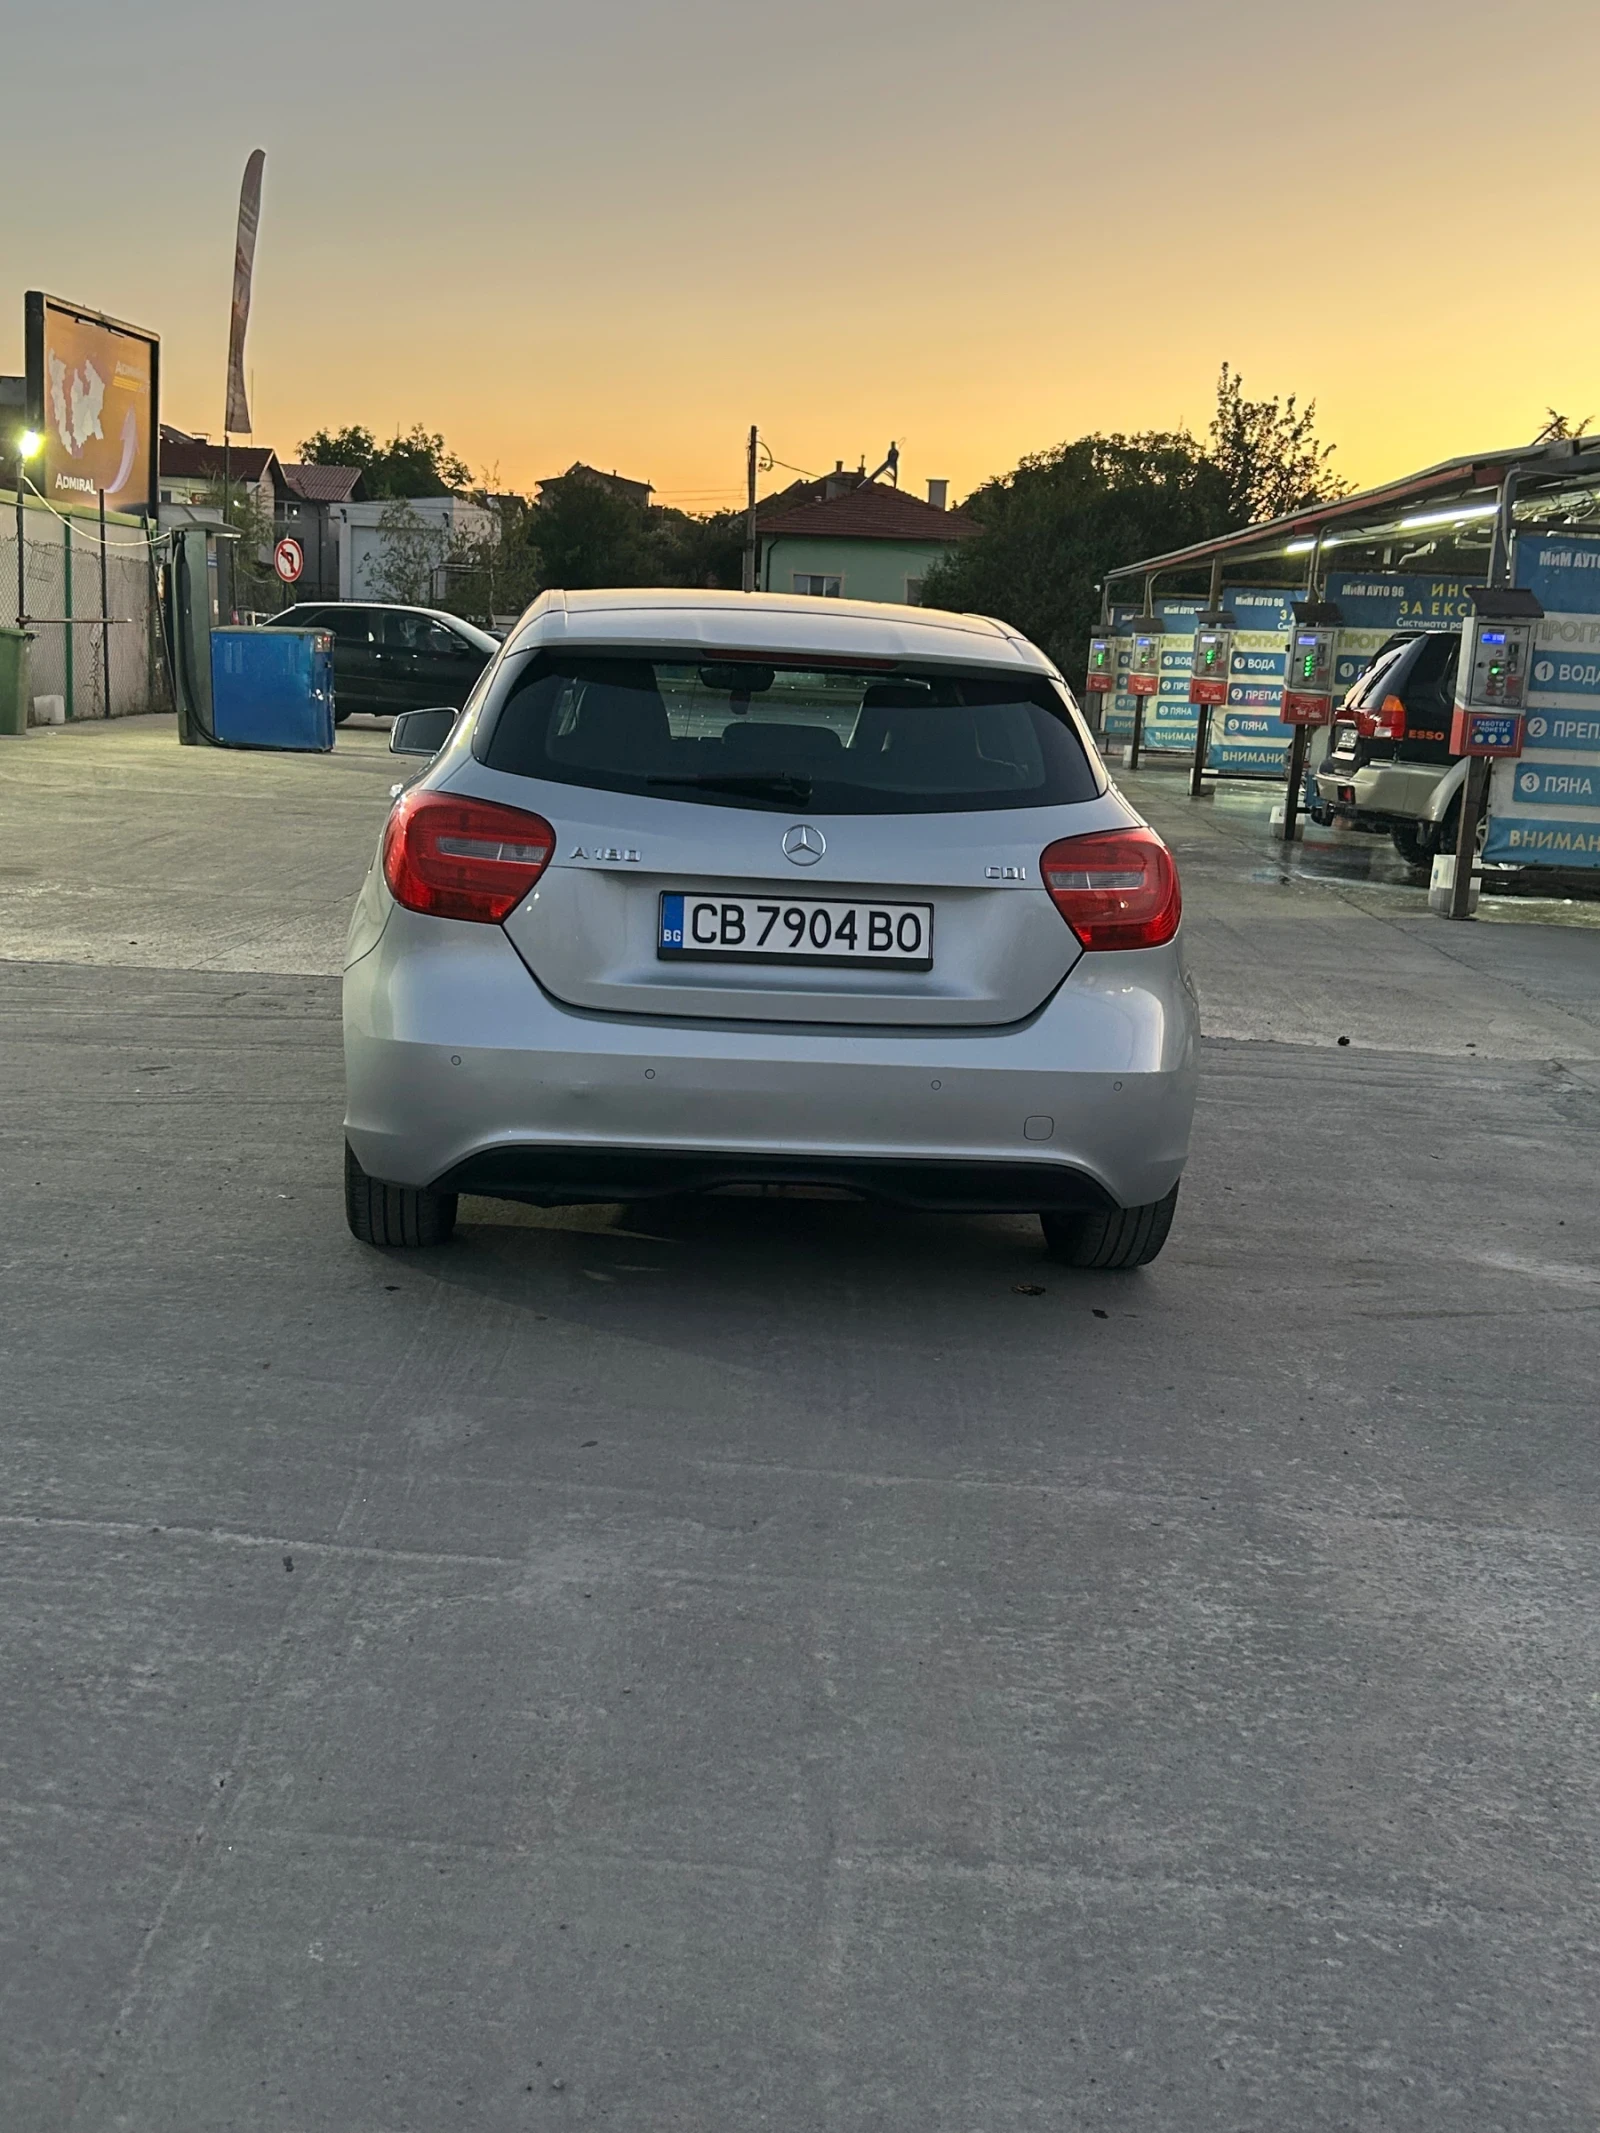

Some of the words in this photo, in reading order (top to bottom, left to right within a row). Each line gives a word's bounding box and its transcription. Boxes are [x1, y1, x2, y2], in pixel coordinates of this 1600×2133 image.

[55, 473, 97, 495] ADMIRAL
[1540, 550, 1571, 567] МиМ
[1367, 585, 1388, 597] АУТО
[1391, 586, 1405, 597] 96
[1431, 583, 1487, 598] ИНС
[1396, 617, 1447, 628] Системата
[1247, 659, 1276, 671] ВОДА
[1170, 706, 1192, 716] ПЯНА
[1241, 720, 1269, 732] ПЯНА
[1530, 718, 1546, 737] 2
[1552, 720, 1600, 739] ПРЕП
[1408, 729, 1445, 741] ESSO
[1523, 774, 1538, 791] 3
[1544, 775, 1593, 795] ПЯНА
[984, 865, 1026, 881] CDI
[663, 929, 682, 943] BG
